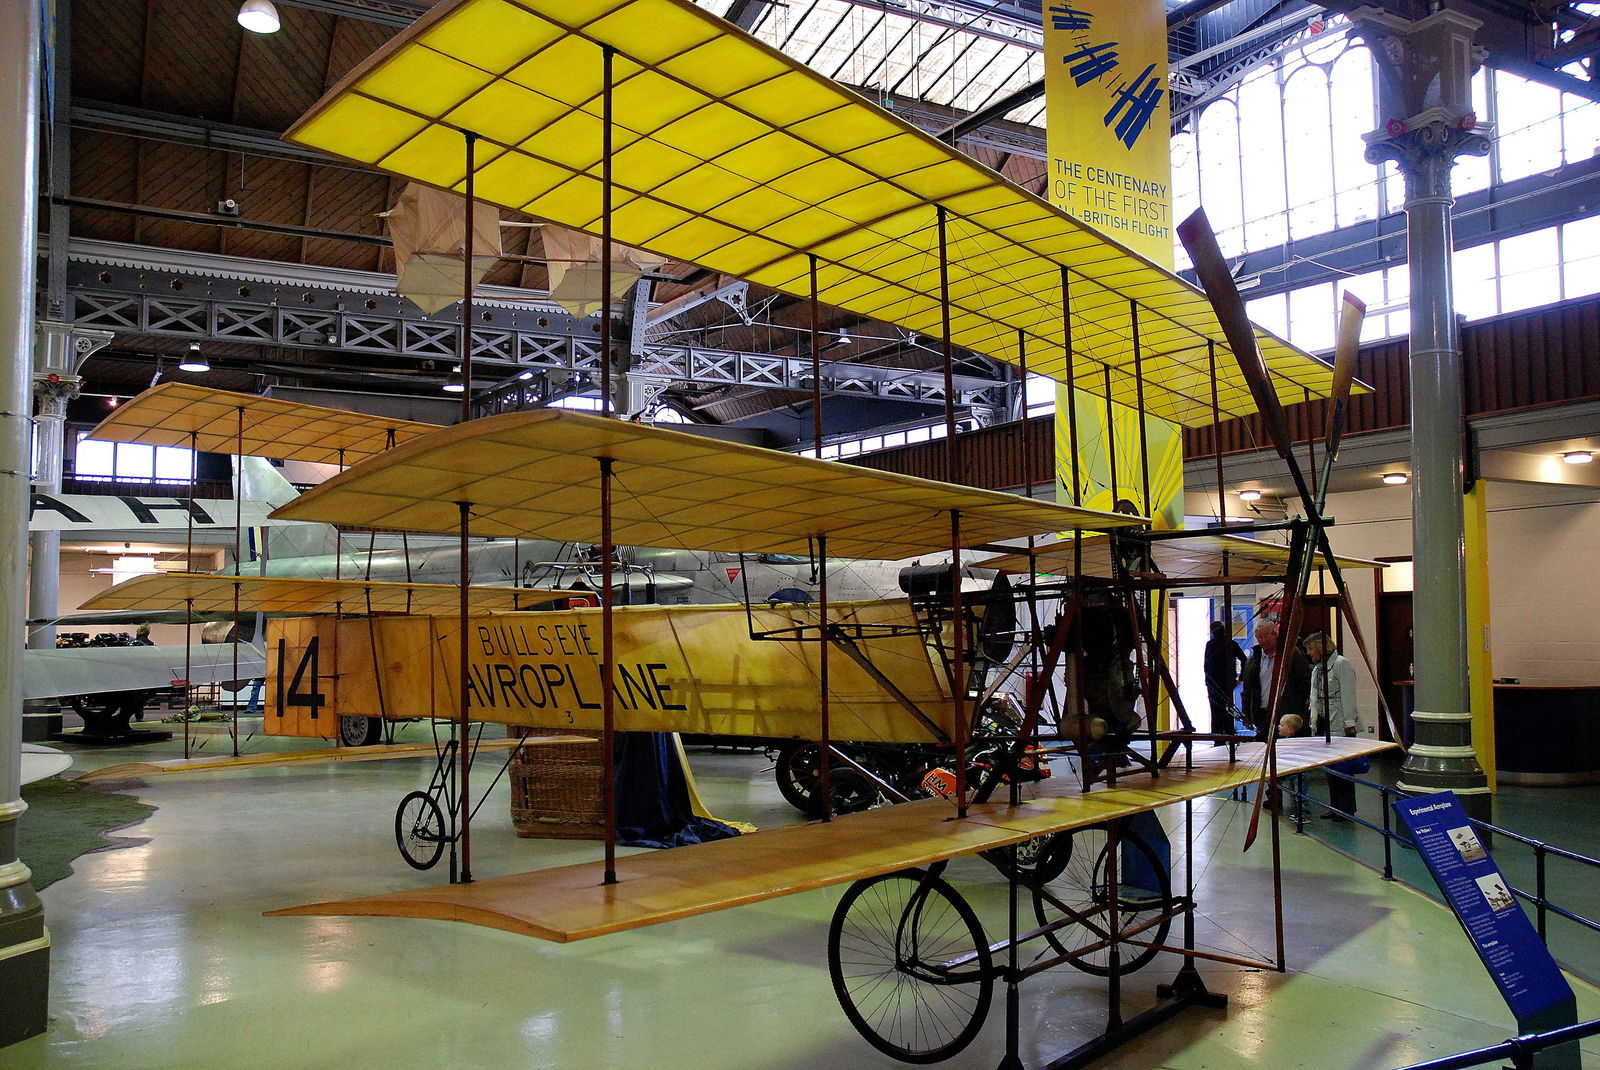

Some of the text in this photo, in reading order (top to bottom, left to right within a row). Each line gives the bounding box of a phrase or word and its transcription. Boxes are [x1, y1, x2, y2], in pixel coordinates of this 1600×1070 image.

[1054, 158, 1167, 199] THE CENTENARY
[1055, 179, 1168, 222] OF THE FIRST
[1058, 204, 1169, 240] LL-BRITISH FLIGHT
[276, 635, 326, 719] 14
[565, 710, 574, 724] 3
